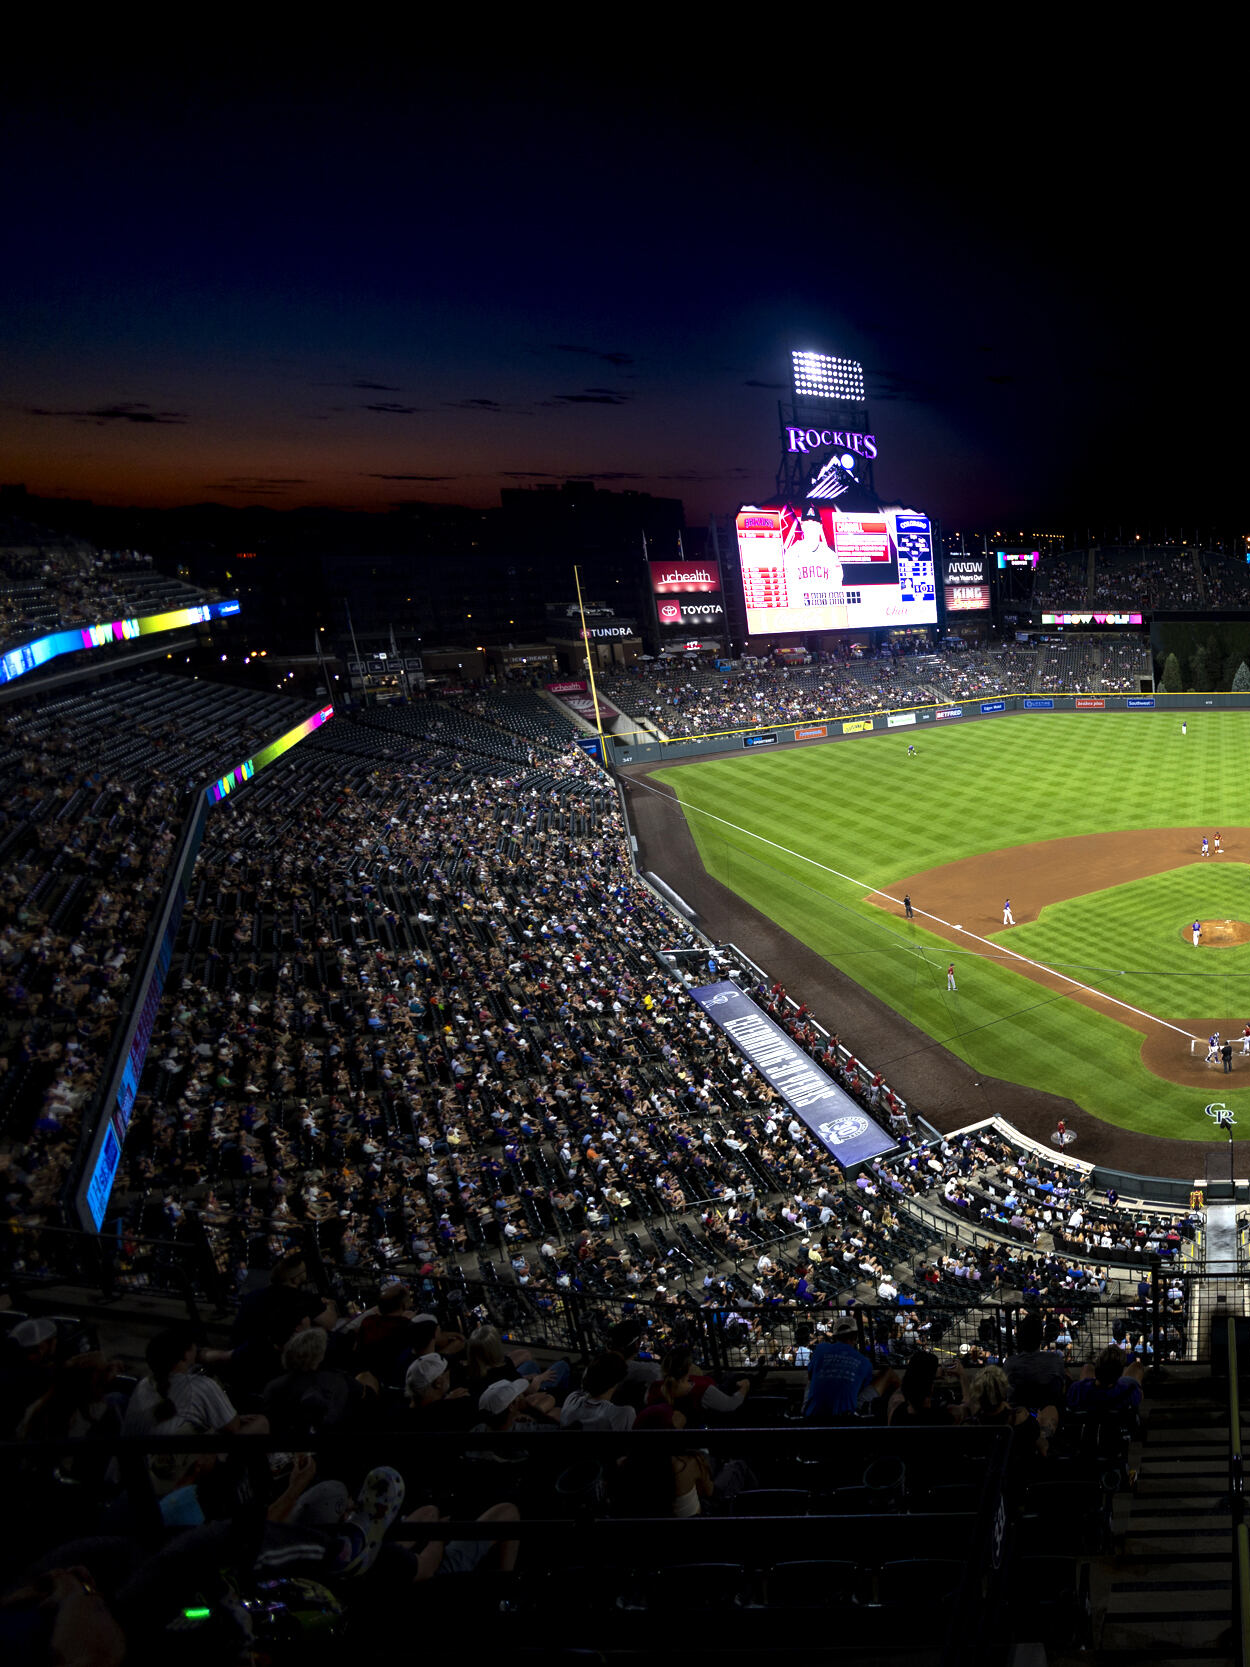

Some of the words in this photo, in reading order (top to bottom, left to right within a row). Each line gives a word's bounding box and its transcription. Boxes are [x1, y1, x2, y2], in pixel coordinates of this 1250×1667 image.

[786, 427, 877, 459] ROCKIES
[662, 570, 711, 582] uchealth
[954, 588, 982, 599] KING
[681, 605, 723, 615] TOYOTA
[1054, 614, 1093, 624] MEOW
[1093, 614, 1130, 624] WOLF
[591, 627, 633, 637] TUNDRA
[937, 710, 961, 718] BETFRED
[723, 1014, 798, 1067] CELEBRATING
[765, 1059, 809, 1080] 30
[777, 1070, 836, 1108] YEARS
